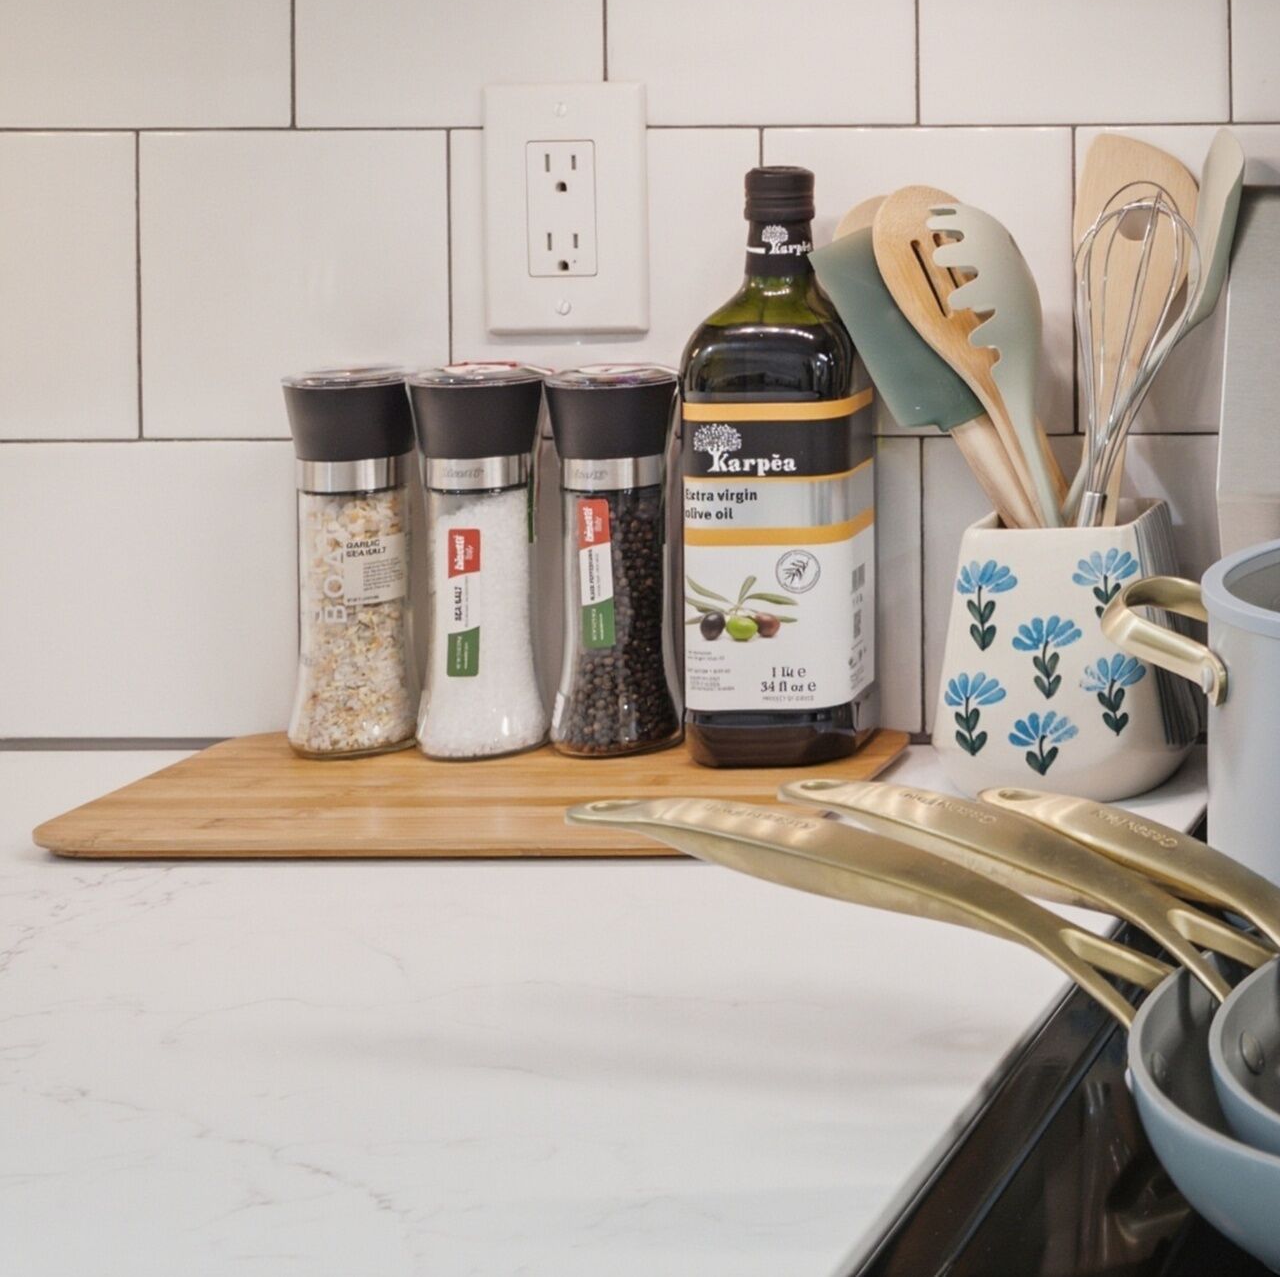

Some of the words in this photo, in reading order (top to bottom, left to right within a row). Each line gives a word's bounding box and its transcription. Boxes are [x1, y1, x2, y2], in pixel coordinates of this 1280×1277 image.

[685, 489, 714, 502] Extra
[717, 489, 758, 504] virgin
[685, 509, 712, 520] olive
[715, 508, 733, 520] oil
[760, 681, 775, 693] 34
